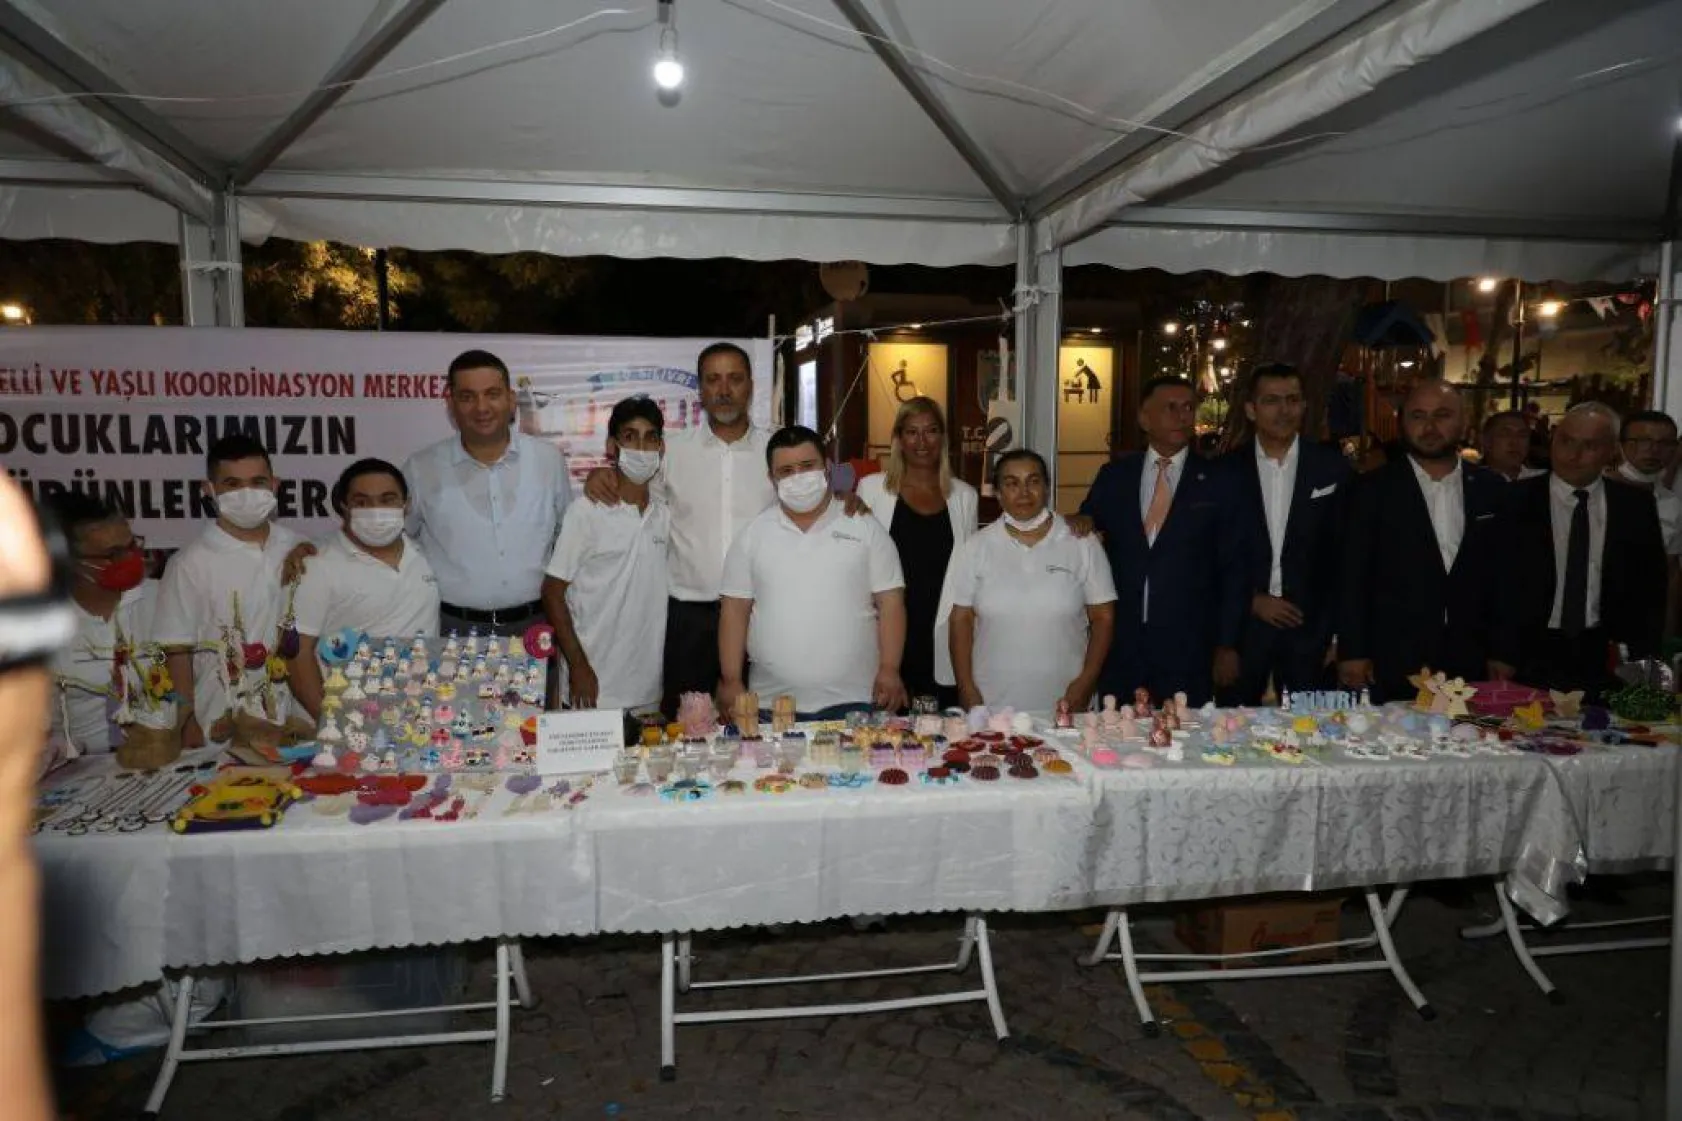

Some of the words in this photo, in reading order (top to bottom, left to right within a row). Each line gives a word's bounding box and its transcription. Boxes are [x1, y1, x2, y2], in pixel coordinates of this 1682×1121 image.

[50, 368, 82, 396] VE
[90, 369, 155, 401] YAŞLI
[164, 366, 354, 399] KOORDİNASYON
